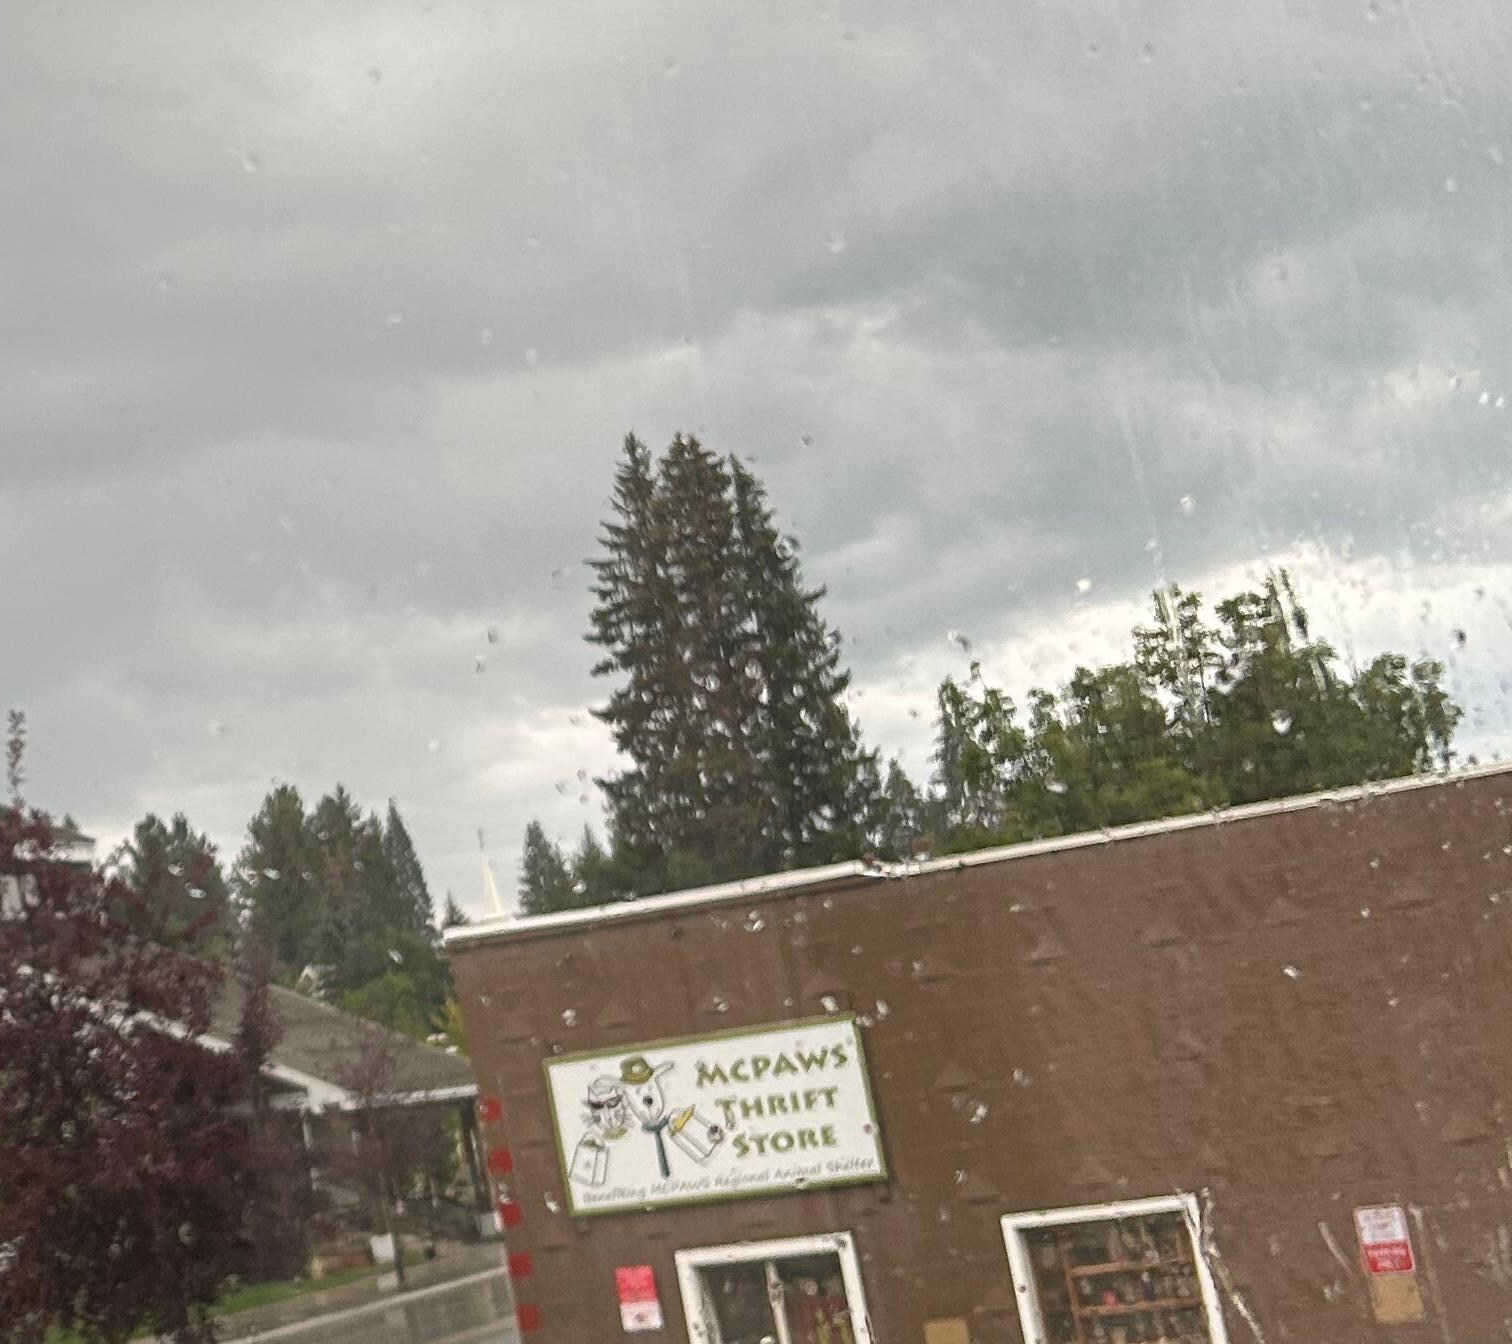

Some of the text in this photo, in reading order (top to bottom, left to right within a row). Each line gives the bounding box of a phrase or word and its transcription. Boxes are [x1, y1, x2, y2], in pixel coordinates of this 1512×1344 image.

[696, 1043, 848, 1087] MCPAWS
[715, 1086, 838, 1128] THRIFT
[733, 1124, 838, 1157] STORE
[714, 1167, 770, 1187] Regional
[774, 1161, 822, 1178] Animal
[826, 1156, 874, 1173] Shelter
